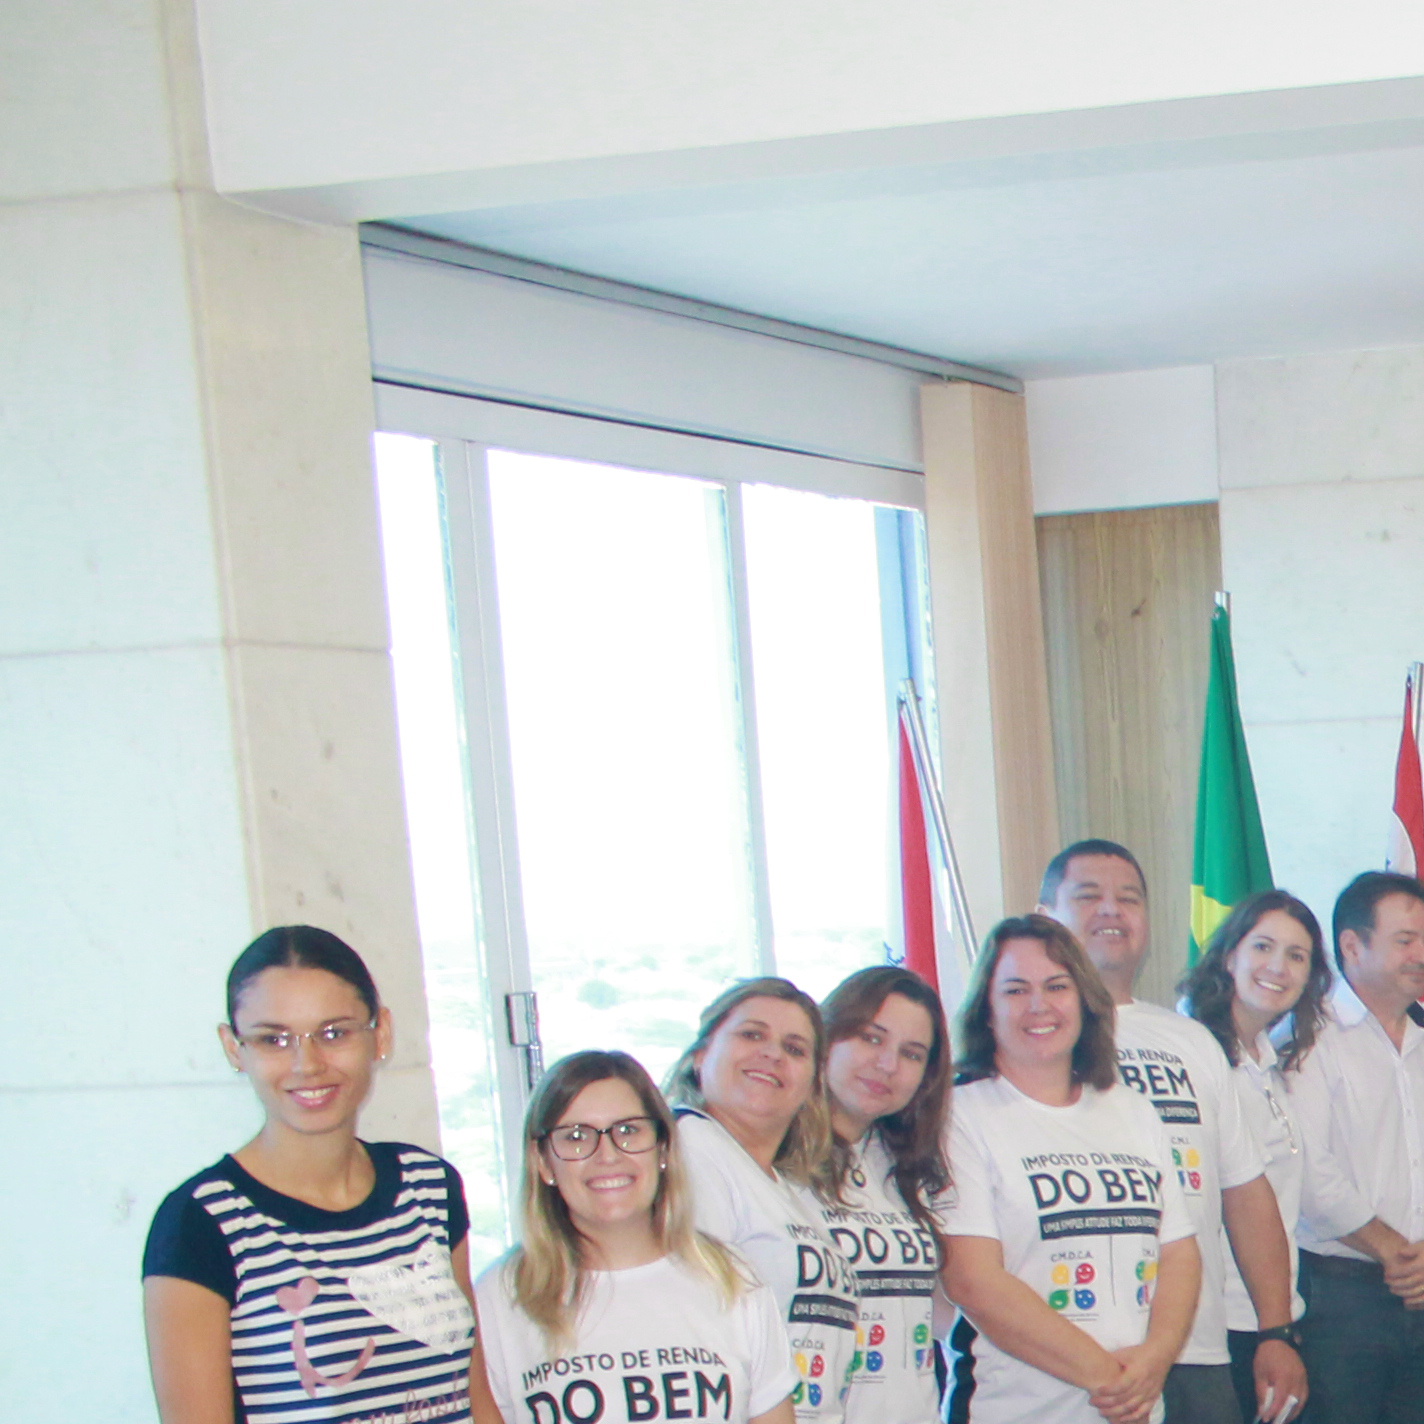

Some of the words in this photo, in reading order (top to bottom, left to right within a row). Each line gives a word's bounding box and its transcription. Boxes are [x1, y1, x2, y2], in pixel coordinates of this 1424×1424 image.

[1136, 1049, 1184, 1066] RENDA
[1118, 1063, 1197, 1099] BEM
[1021, 1153, 1088, 1171] IMPOSTO
[1028, 1169, 1091, 1210] DO
[883, 1212, 902, 1225] DE
[829, 1227, 889, 1264] DO
[892, 1228, 936, 1264] BE
[522, 1353, 615, 1391] IMPOSTO
[621, 1350, 649, 1369] DE
[656, 1347, 727, 1368] RENDA
[623, 1370, 732, 1422] BEM
